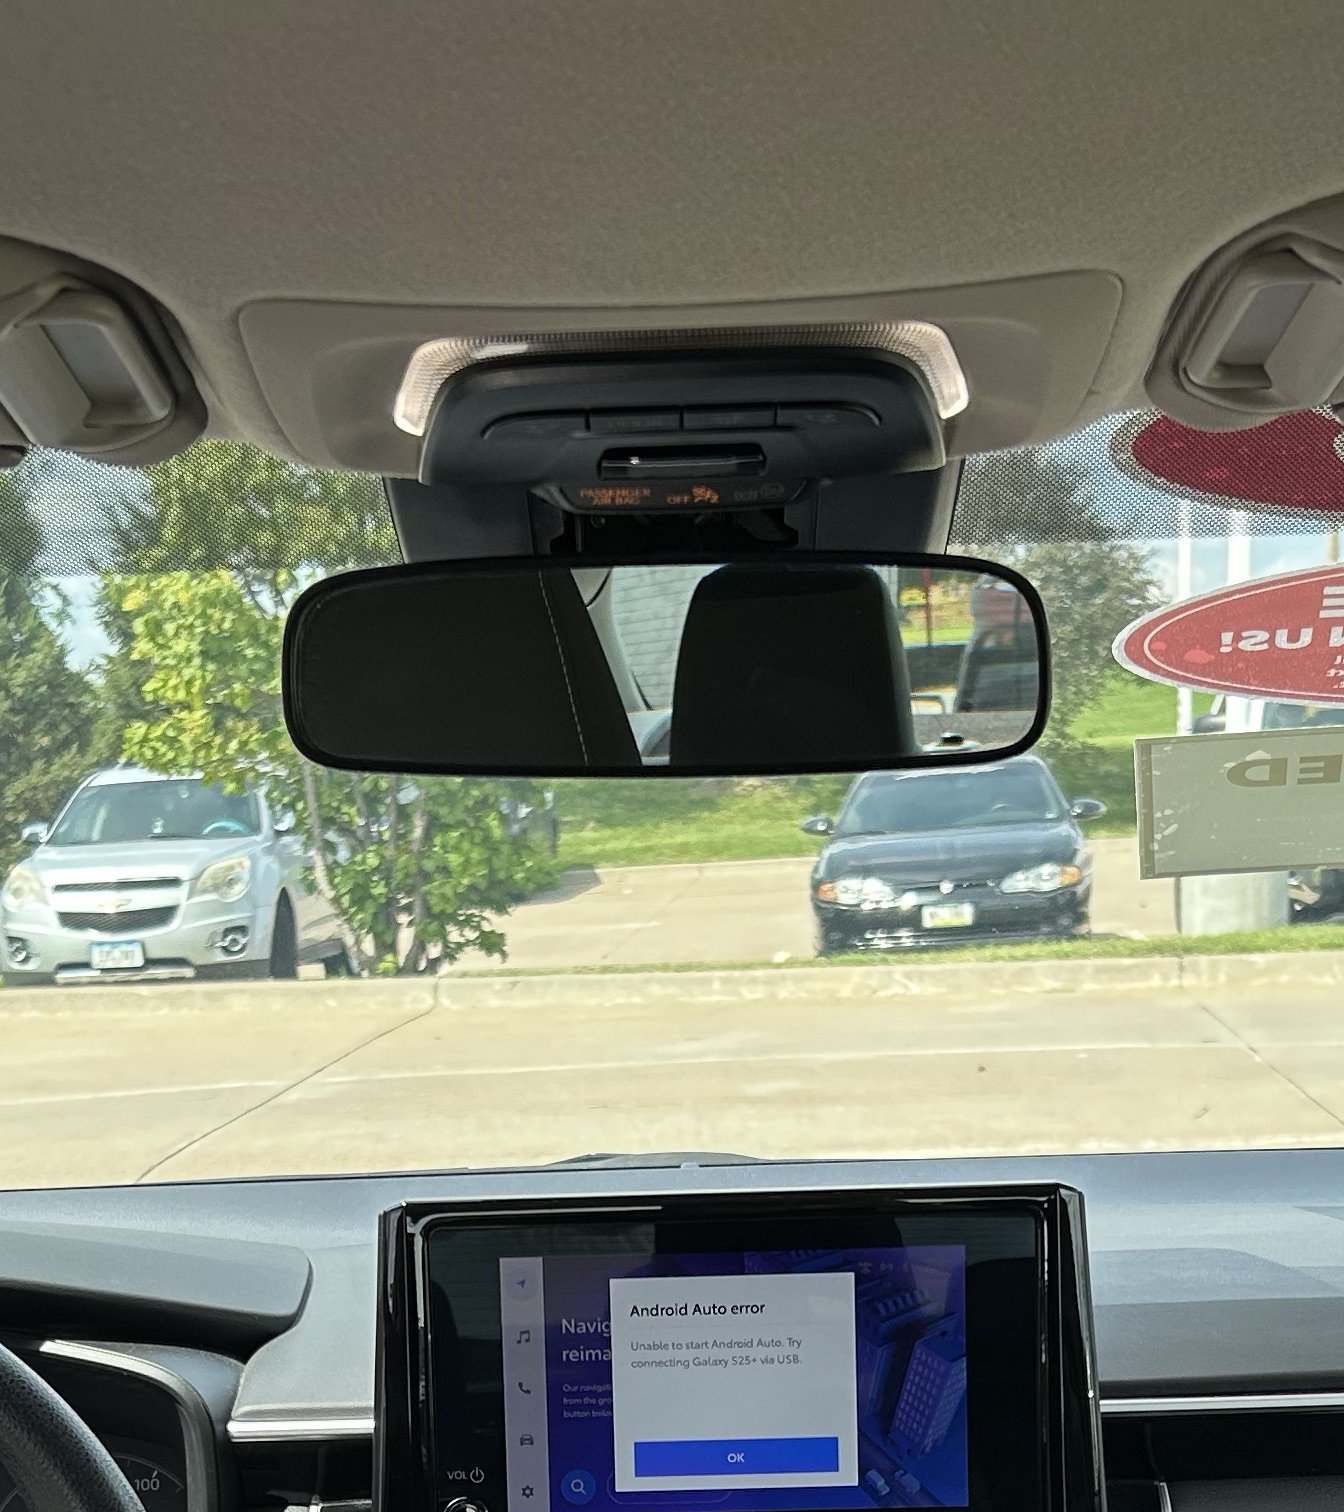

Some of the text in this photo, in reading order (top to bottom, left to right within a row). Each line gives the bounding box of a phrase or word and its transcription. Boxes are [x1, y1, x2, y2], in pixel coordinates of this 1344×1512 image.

[666, 496, 691, 505] OFF
[630, 1303, 766, 1317] Android Auto error
[630, 1337, 803, 1352] Unable to start Android Auto. Try
[631, 1354, 803, 1370] connecting Galaxy S25+ via USB.
[727, 1452, 745, 1463] OK
[446, 1470, 468, 1480] VOL
[134, 1478, 160, 1492] 100
